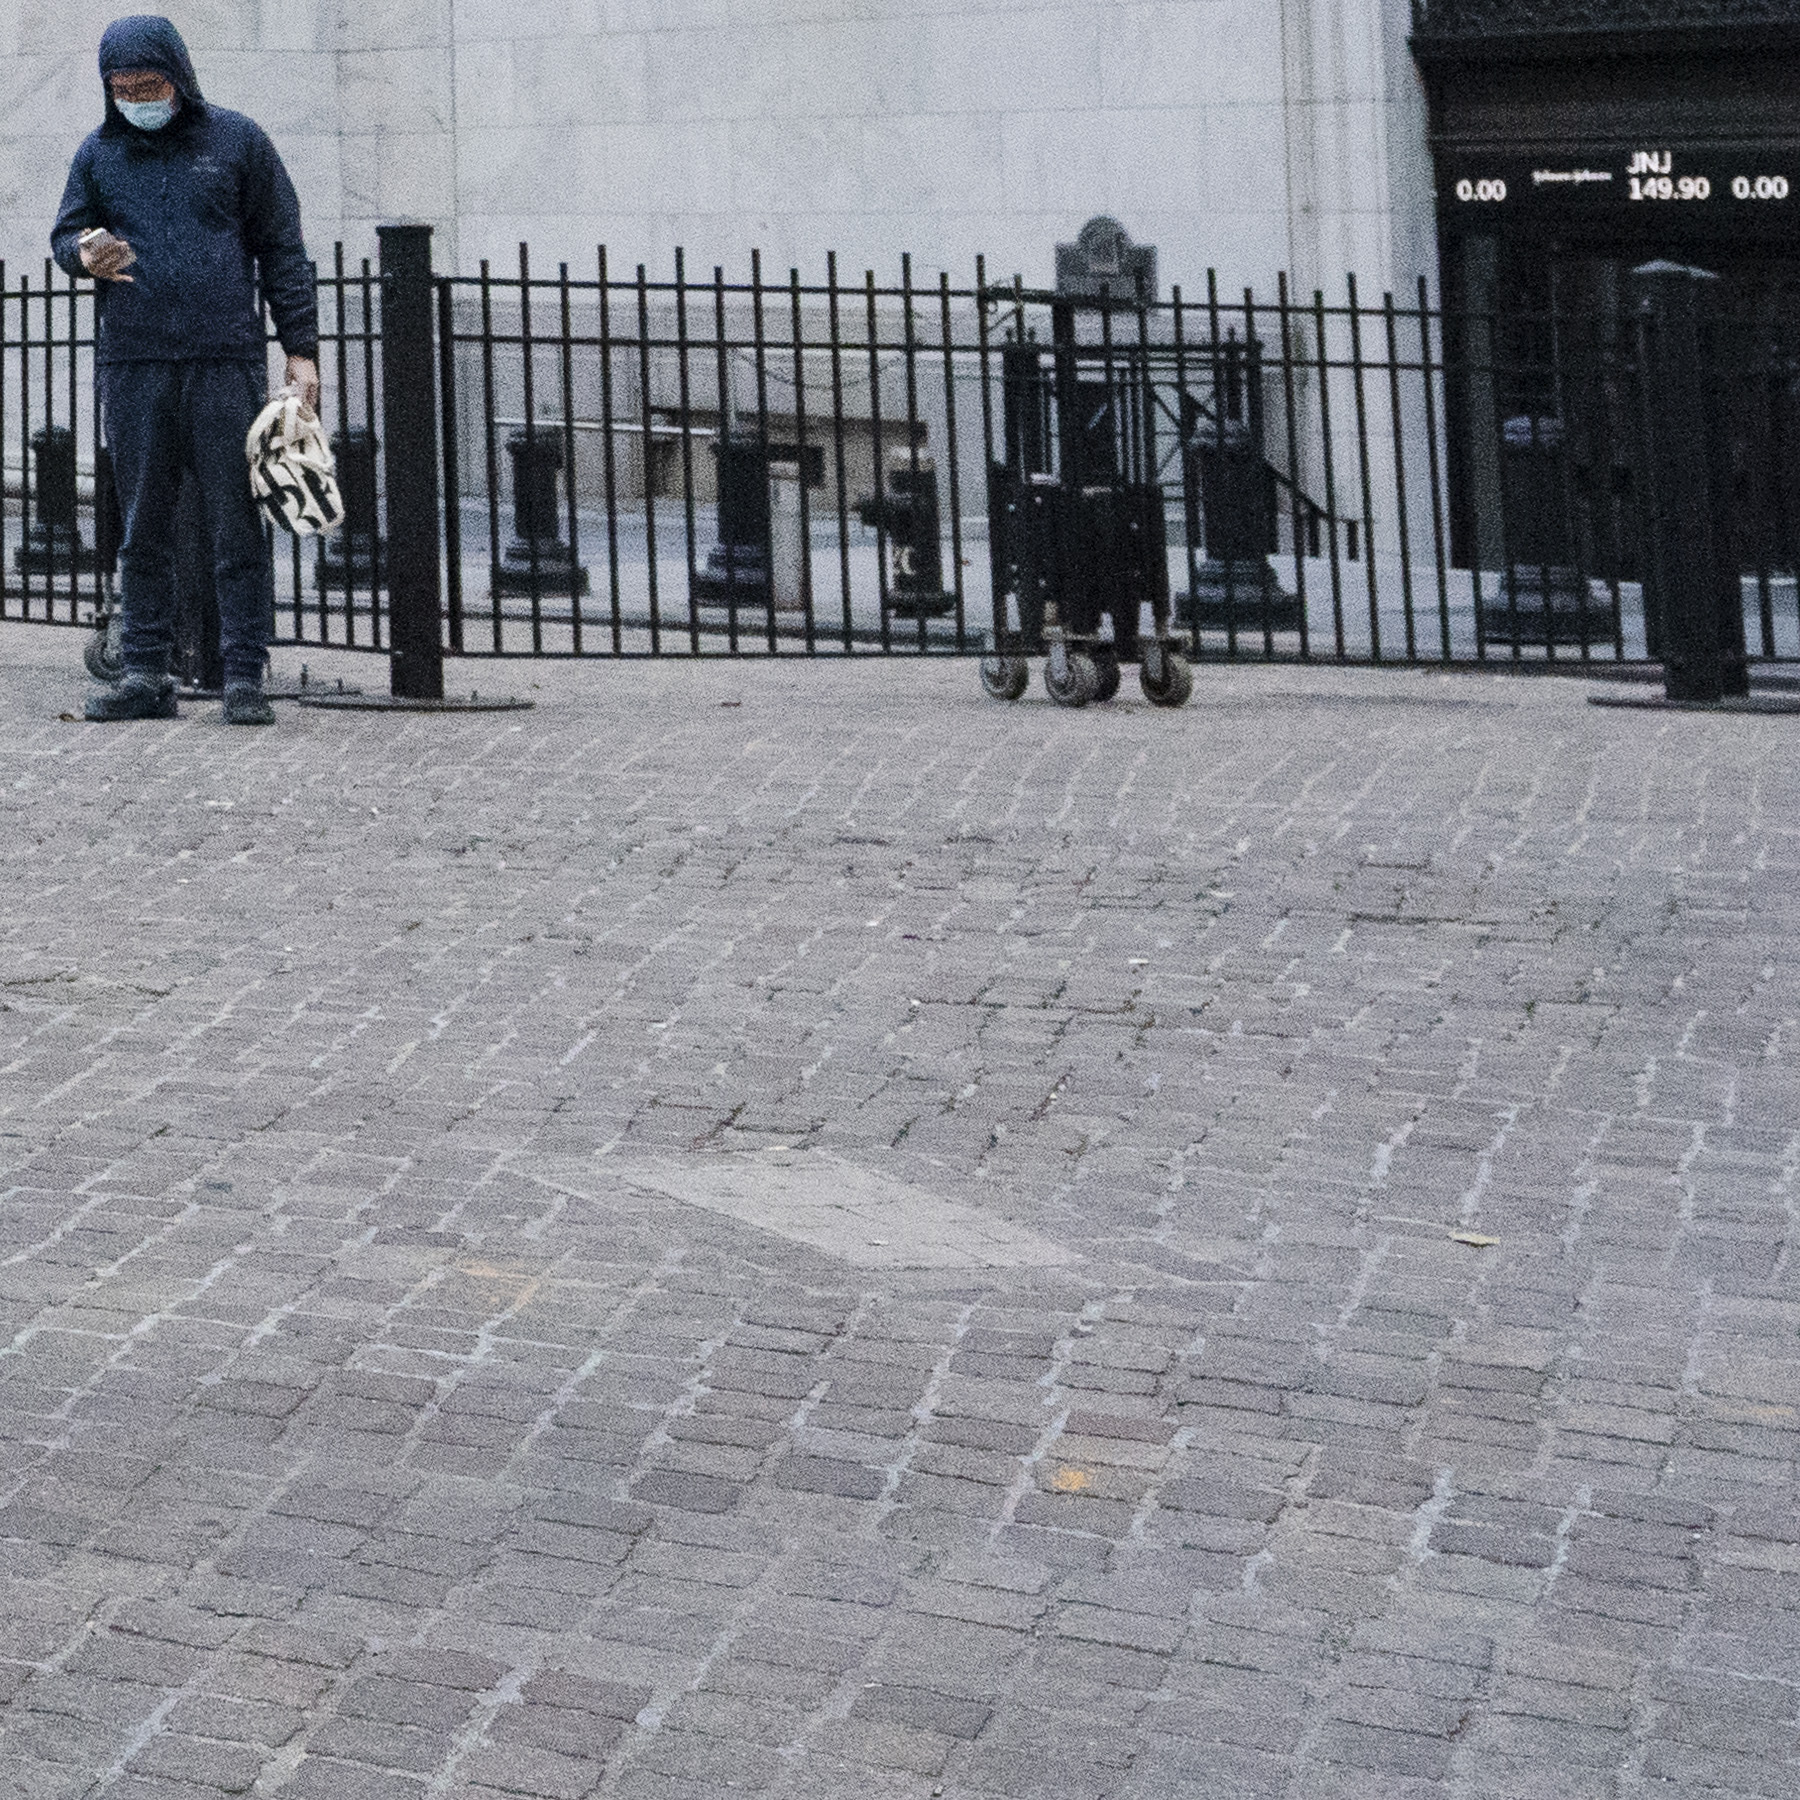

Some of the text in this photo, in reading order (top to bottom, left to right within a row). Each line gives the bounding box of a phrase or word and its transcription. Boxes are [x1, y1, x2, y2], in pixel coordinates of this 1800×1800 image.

[1626, 150, 1672, 174] JNJ
[1455, 178, 1507, 202] 0.00
[1628, 176, 1711, 201] 149.90
[1731, 175, 1789, 200] 0.00
